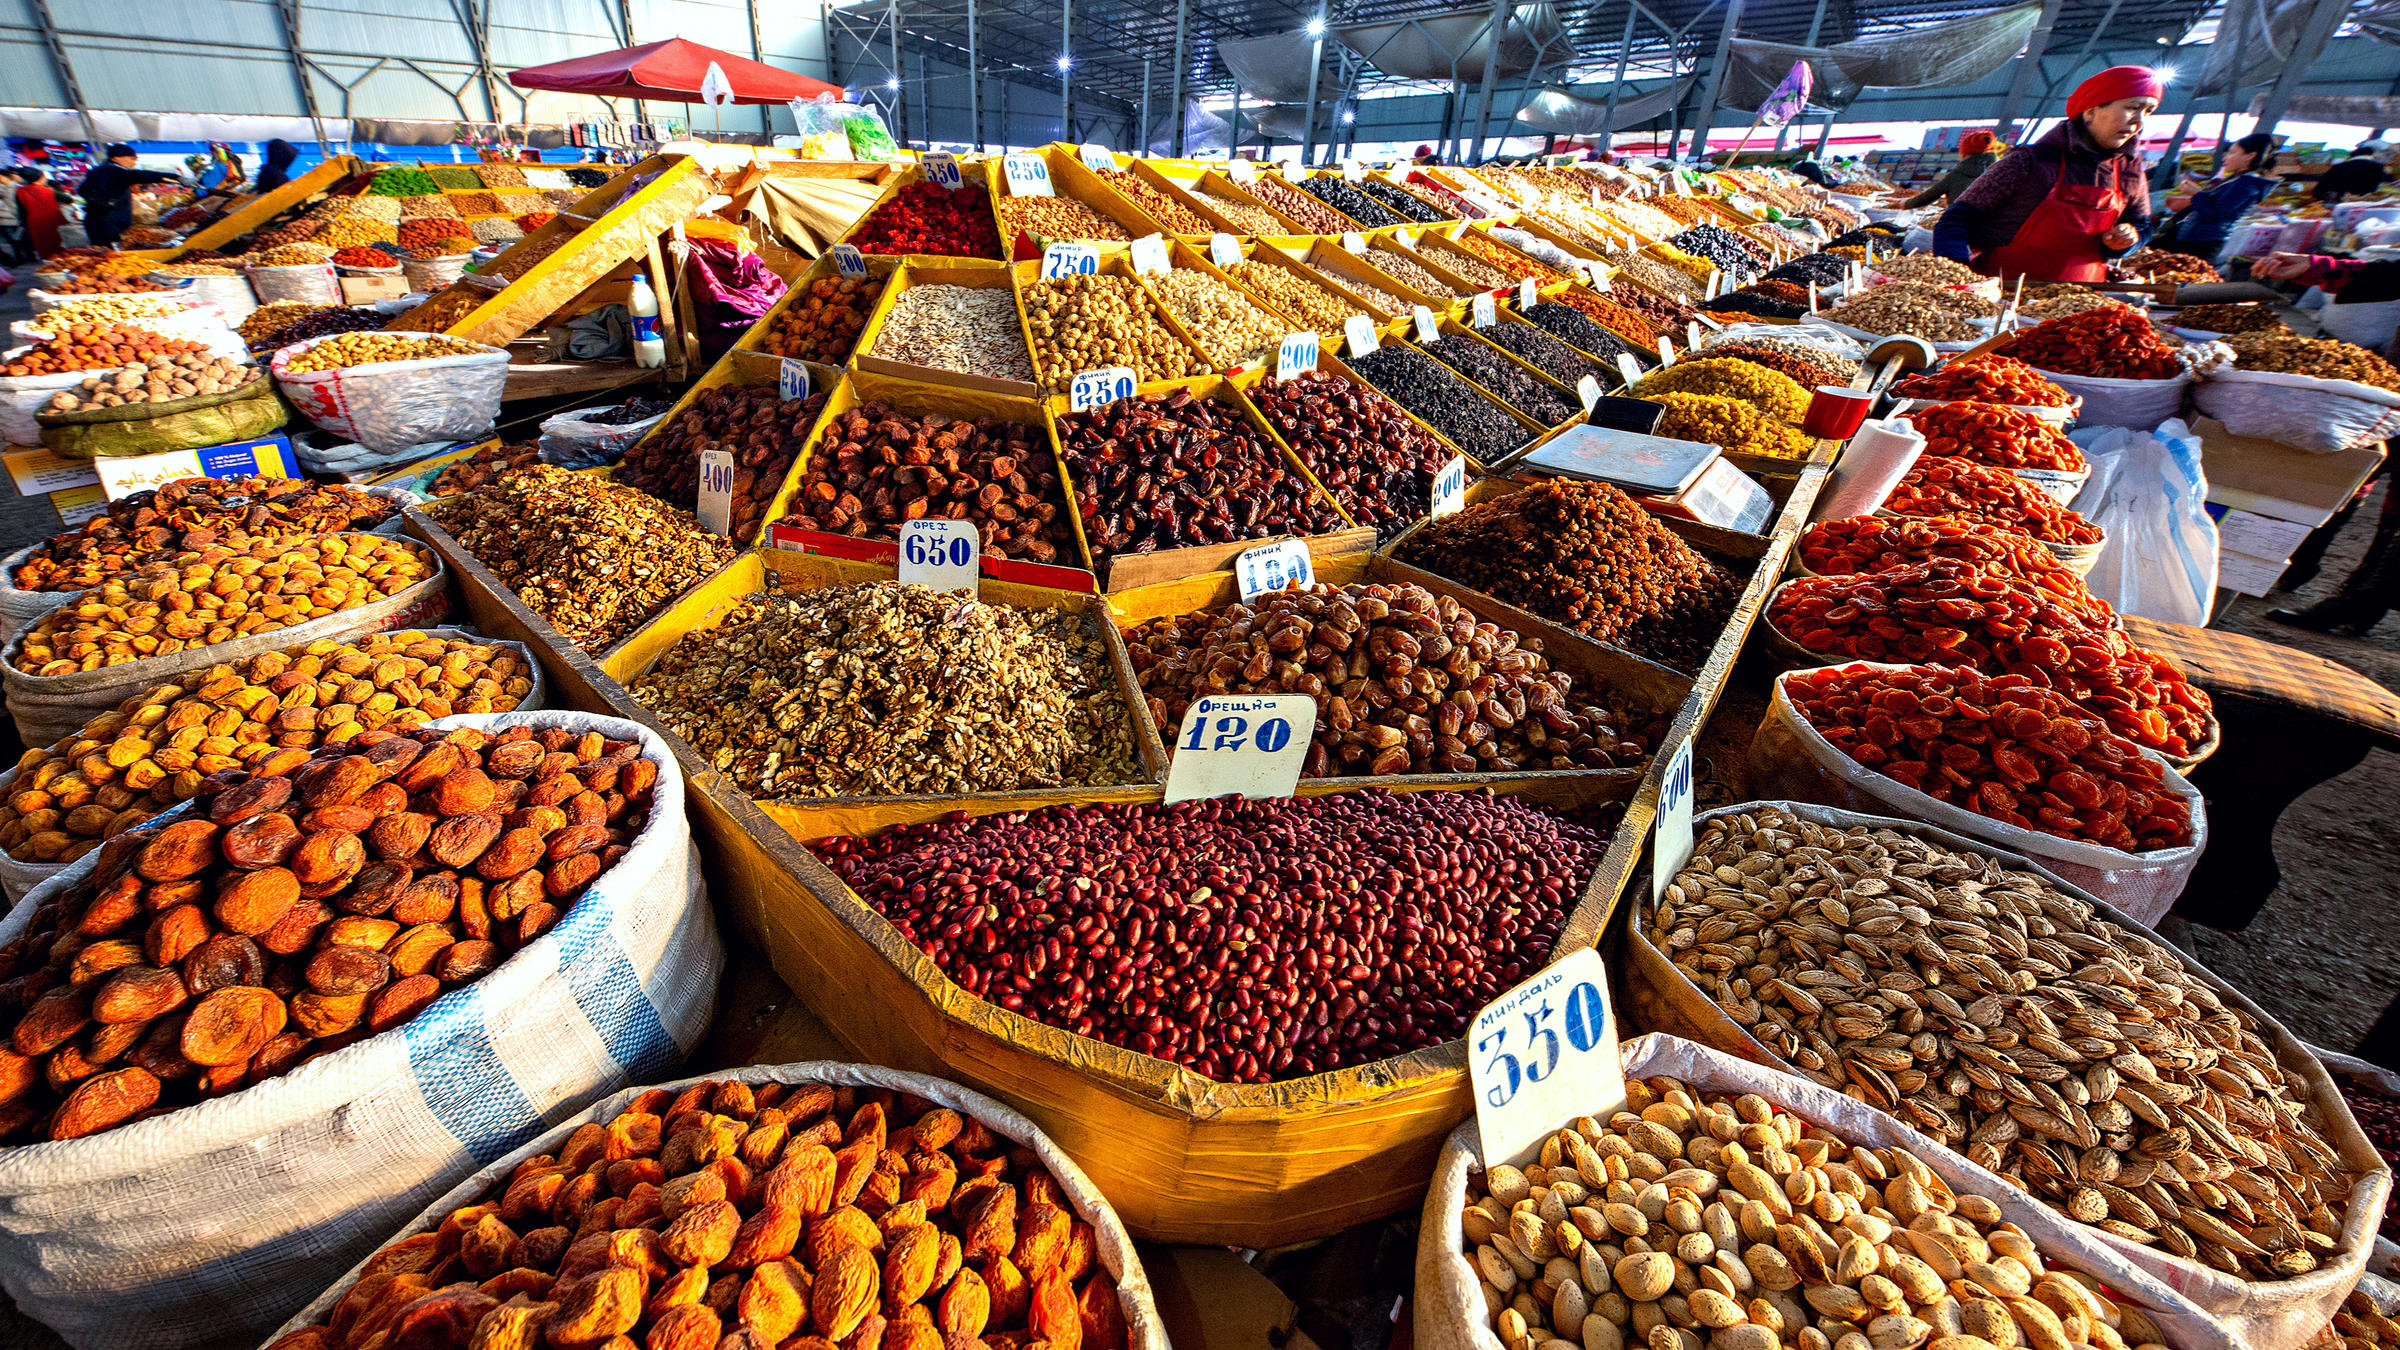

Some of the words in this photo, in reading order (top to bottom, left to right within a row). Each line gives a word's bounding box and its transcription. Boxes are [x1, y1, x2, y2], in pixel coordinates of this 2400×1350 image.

[923, 162, 960, 184] 350
[1008, 160, 1046, 181] 250
[835, 252, 864, 273] 200
[1049, 253, 1096, 279] 750
[1282, 343, 1316, 371] 200
[782, 366, 807, 400] 280
[1075, 377, 1133, 408] 250
[703, 463, 732, 494] 400
[1433, 468, 1461, 508] 200
[913, 521, 948, 531] ОРЕХ
[906, 534, 971, 566] 650
[1247, 555, 1307, 595] 180
[1180, 716, 1291, 752] 120
[1658, 754, 1689, 829] 600
[1478, 982, 1604, 1107] 350
